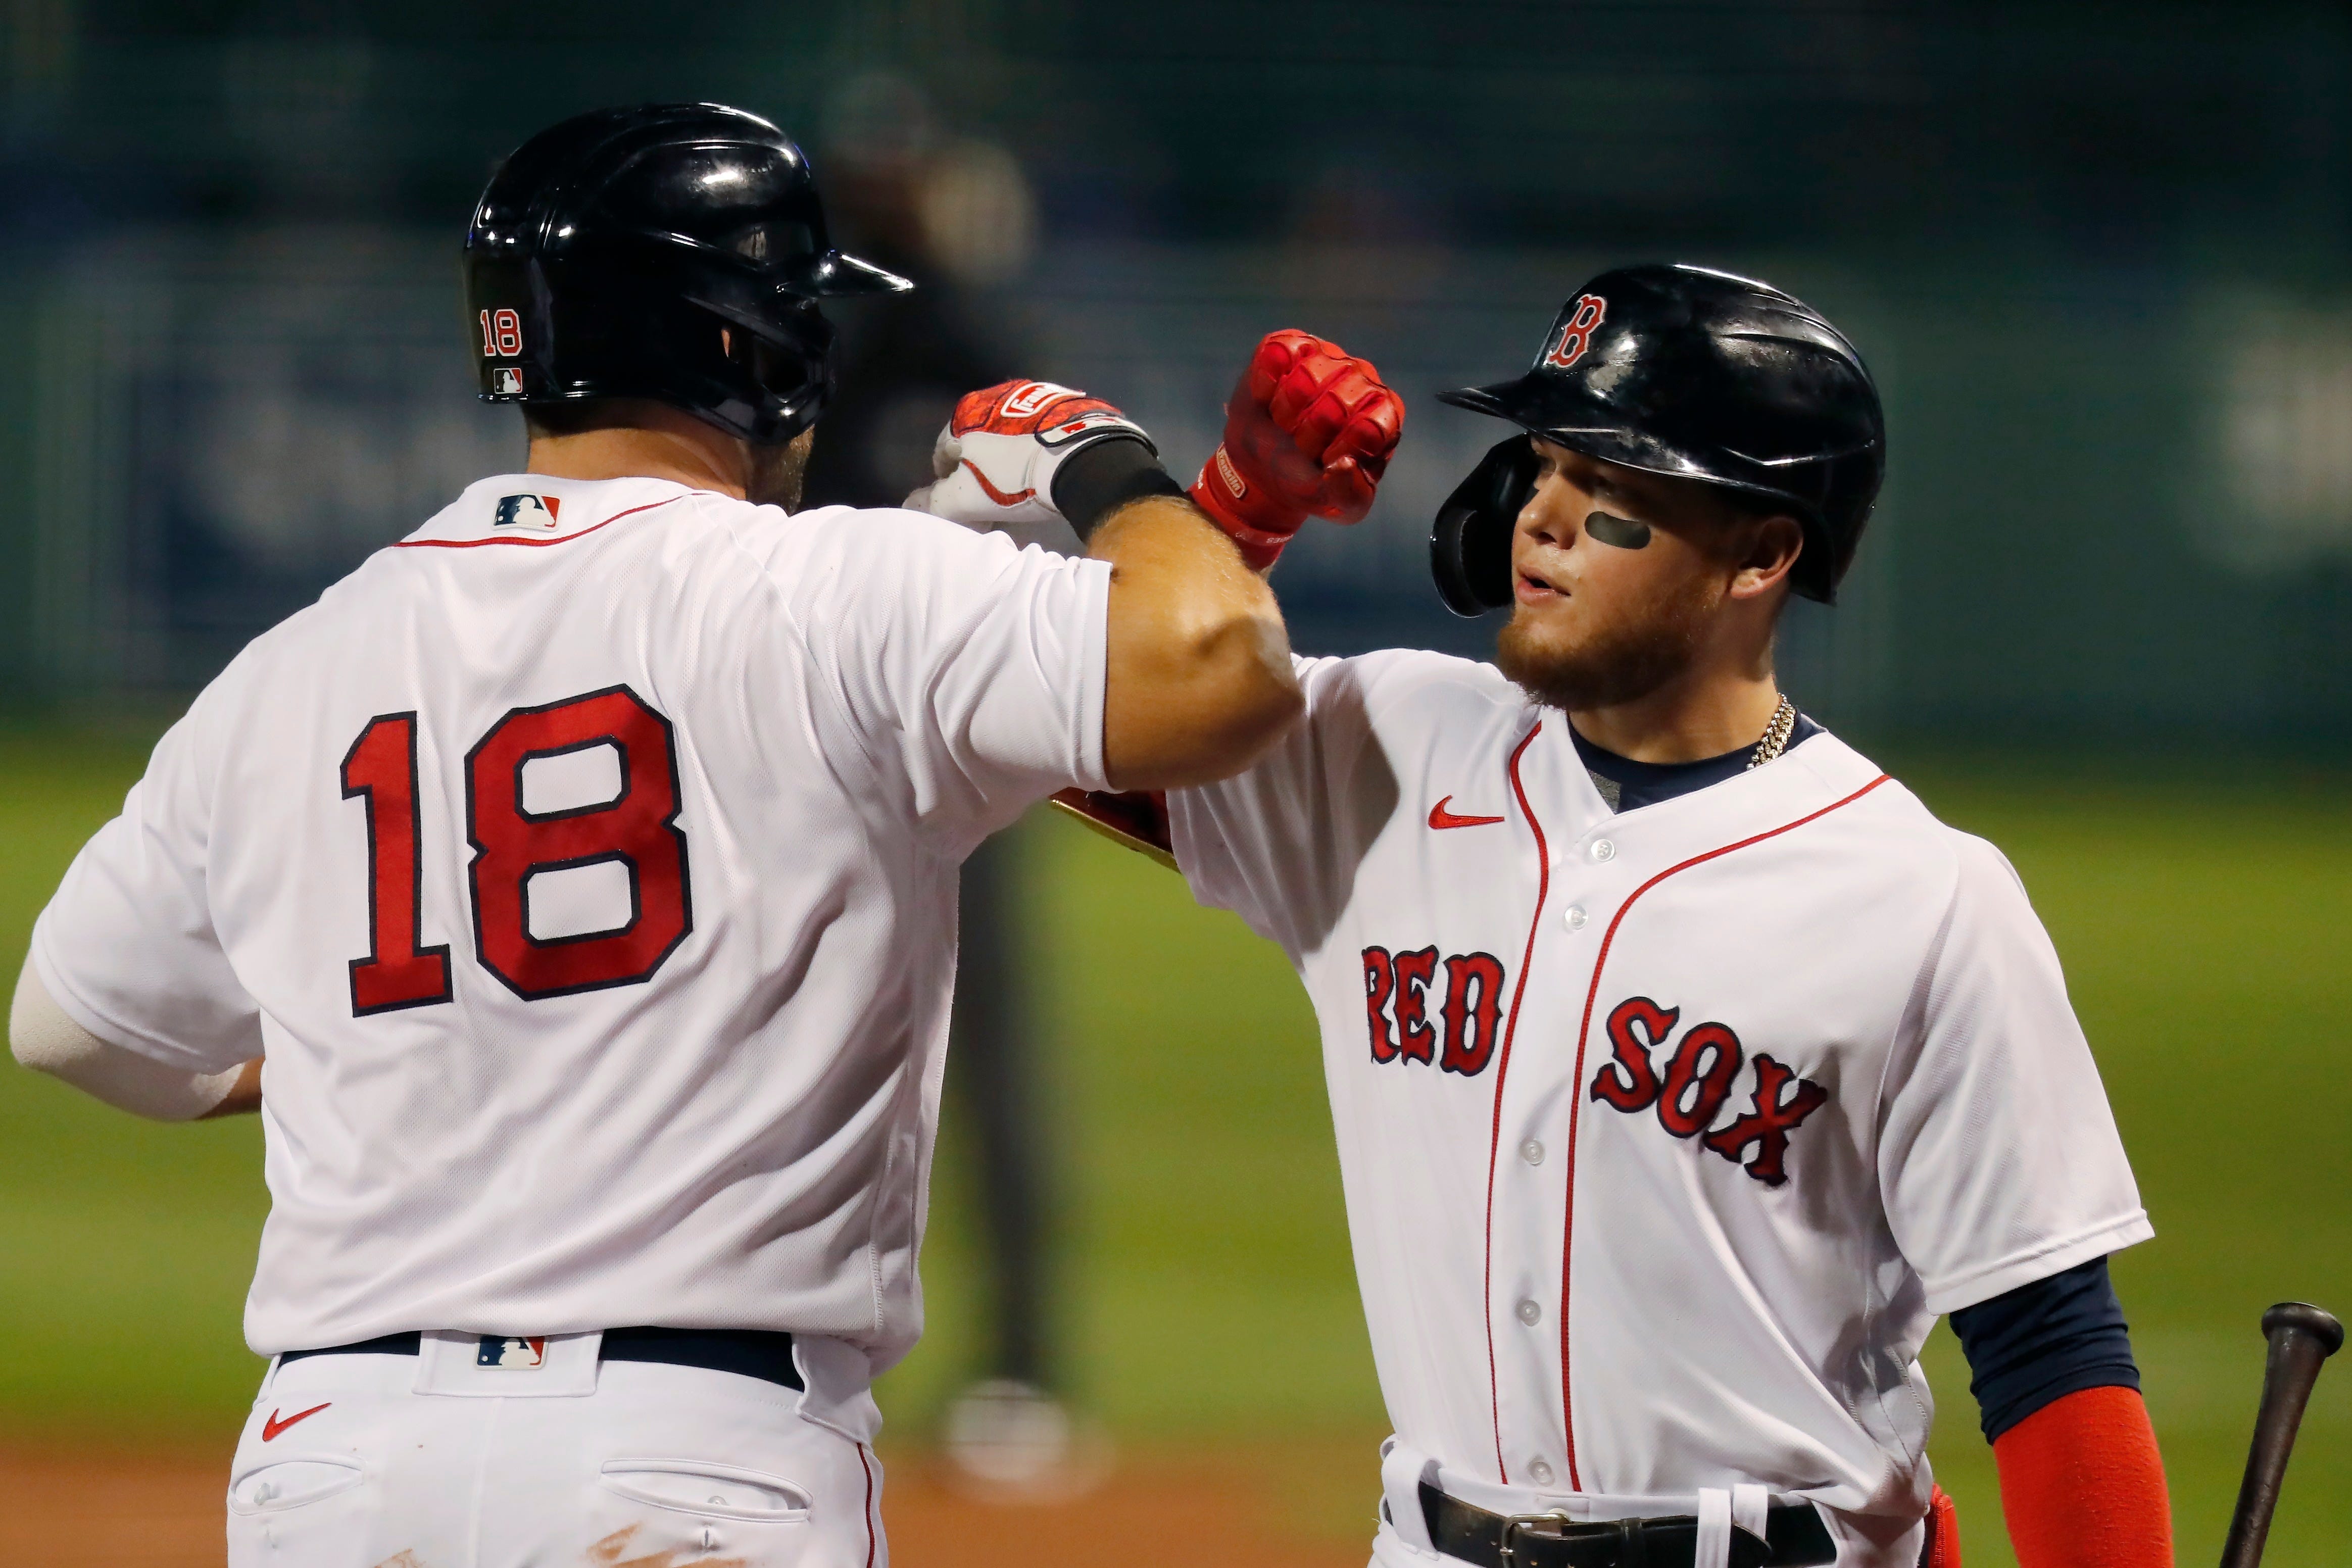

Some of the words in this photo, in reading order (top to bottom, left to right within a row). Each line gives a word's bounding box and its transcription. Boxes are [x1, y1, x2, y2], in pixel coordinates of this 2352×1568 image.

[480, 308, 523, 357] 18
[1547, 293, 1607, 368] B
[340, 683, 693, 1018] 18
[1362, 945, 1505, 1076] RED
[1590, 996, 1828, 1186] SOX
